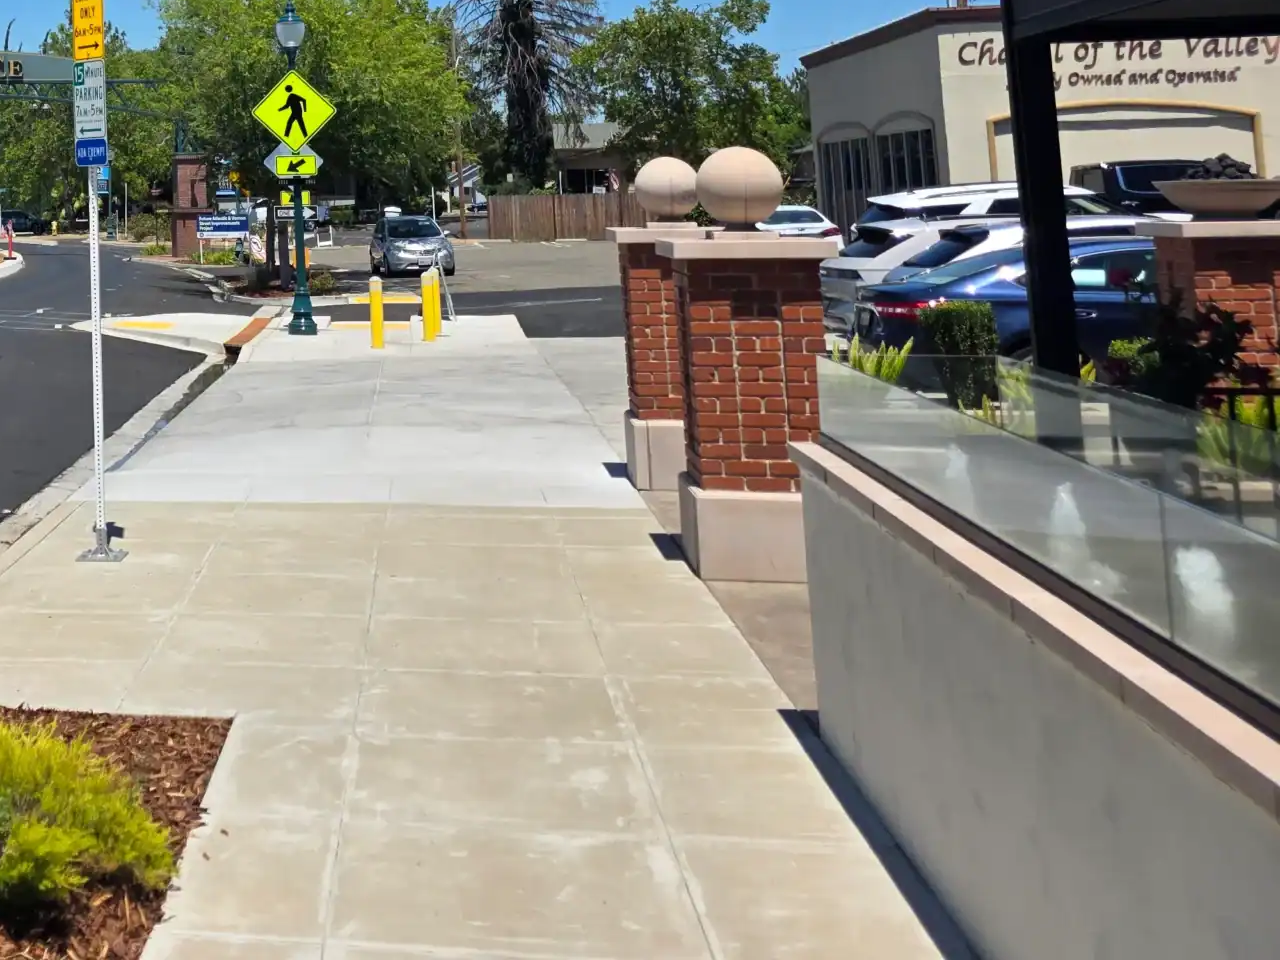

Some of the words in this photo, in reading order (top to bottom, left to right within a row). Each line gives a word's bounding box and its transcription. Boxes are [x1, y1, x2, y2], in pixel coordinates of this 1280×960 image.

[80, 6, 95, 19] ONLY
[1074, 41, 1104, 70] of
[1114, 40, 1163, 61] the
[1184, 37, 1280, 64] Valley
[74, 66, 84, 83] 15
[85, 66, 103, 78] MINUTE
[1068, 69, 1126, 87] Owned
[1129, 69, 1163, 85] and
[1165, 67, 1241, 88] Operated
[75, 86, 103, 101] PARKING
[77, 147, 87, 158] ADA
[88, 146, 105, 157] EXEMPT
